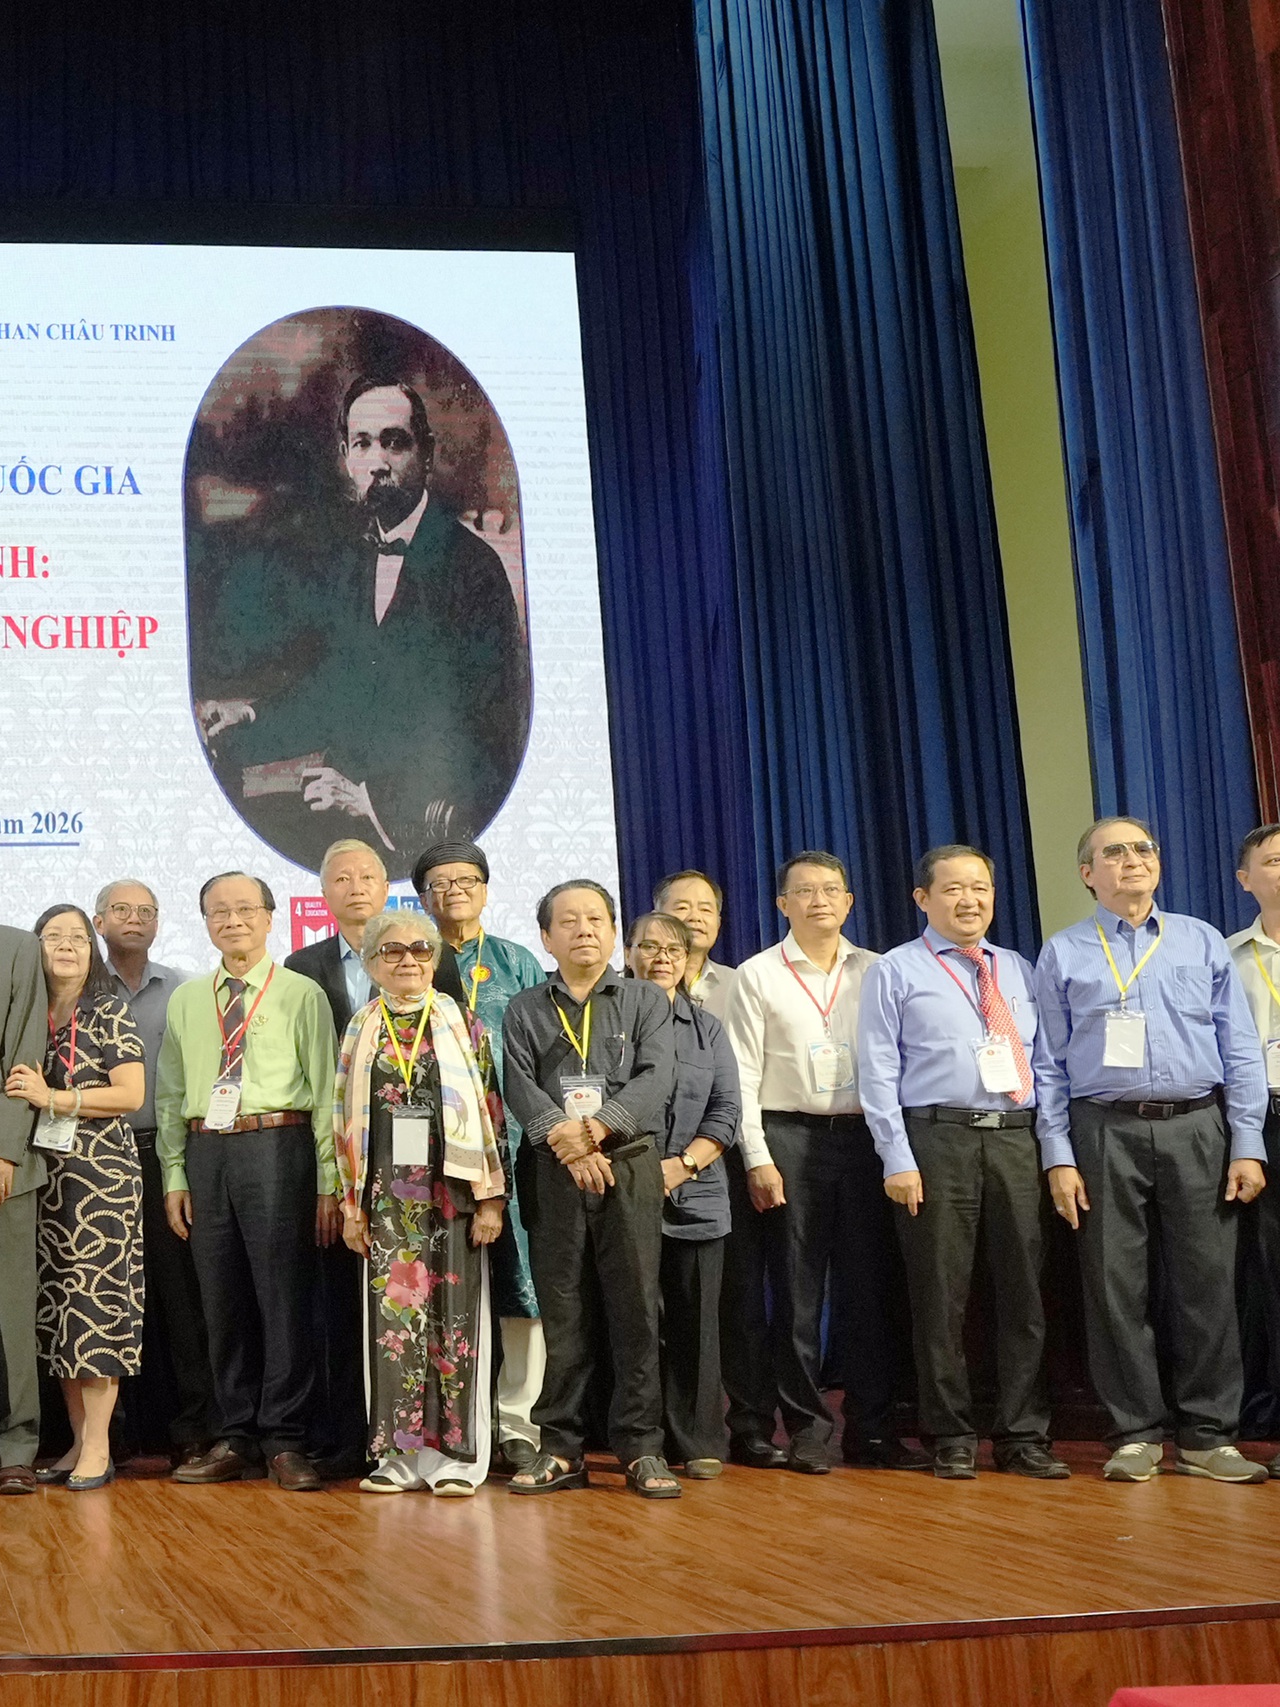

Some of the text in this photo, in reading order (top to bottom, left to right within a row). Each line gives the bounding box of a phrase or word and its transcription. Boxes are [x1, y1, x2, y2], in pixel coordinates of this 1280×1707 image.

[46, 318, 105, 342] CHÂU
[110, 323, 177, 342] TRINH
[73, 464, 144, 496] GIA
[1, 609, 160, 659] NGHIỆP
[31, 810, 84, 834] 2026
[294, 901, 303, 917] 4
